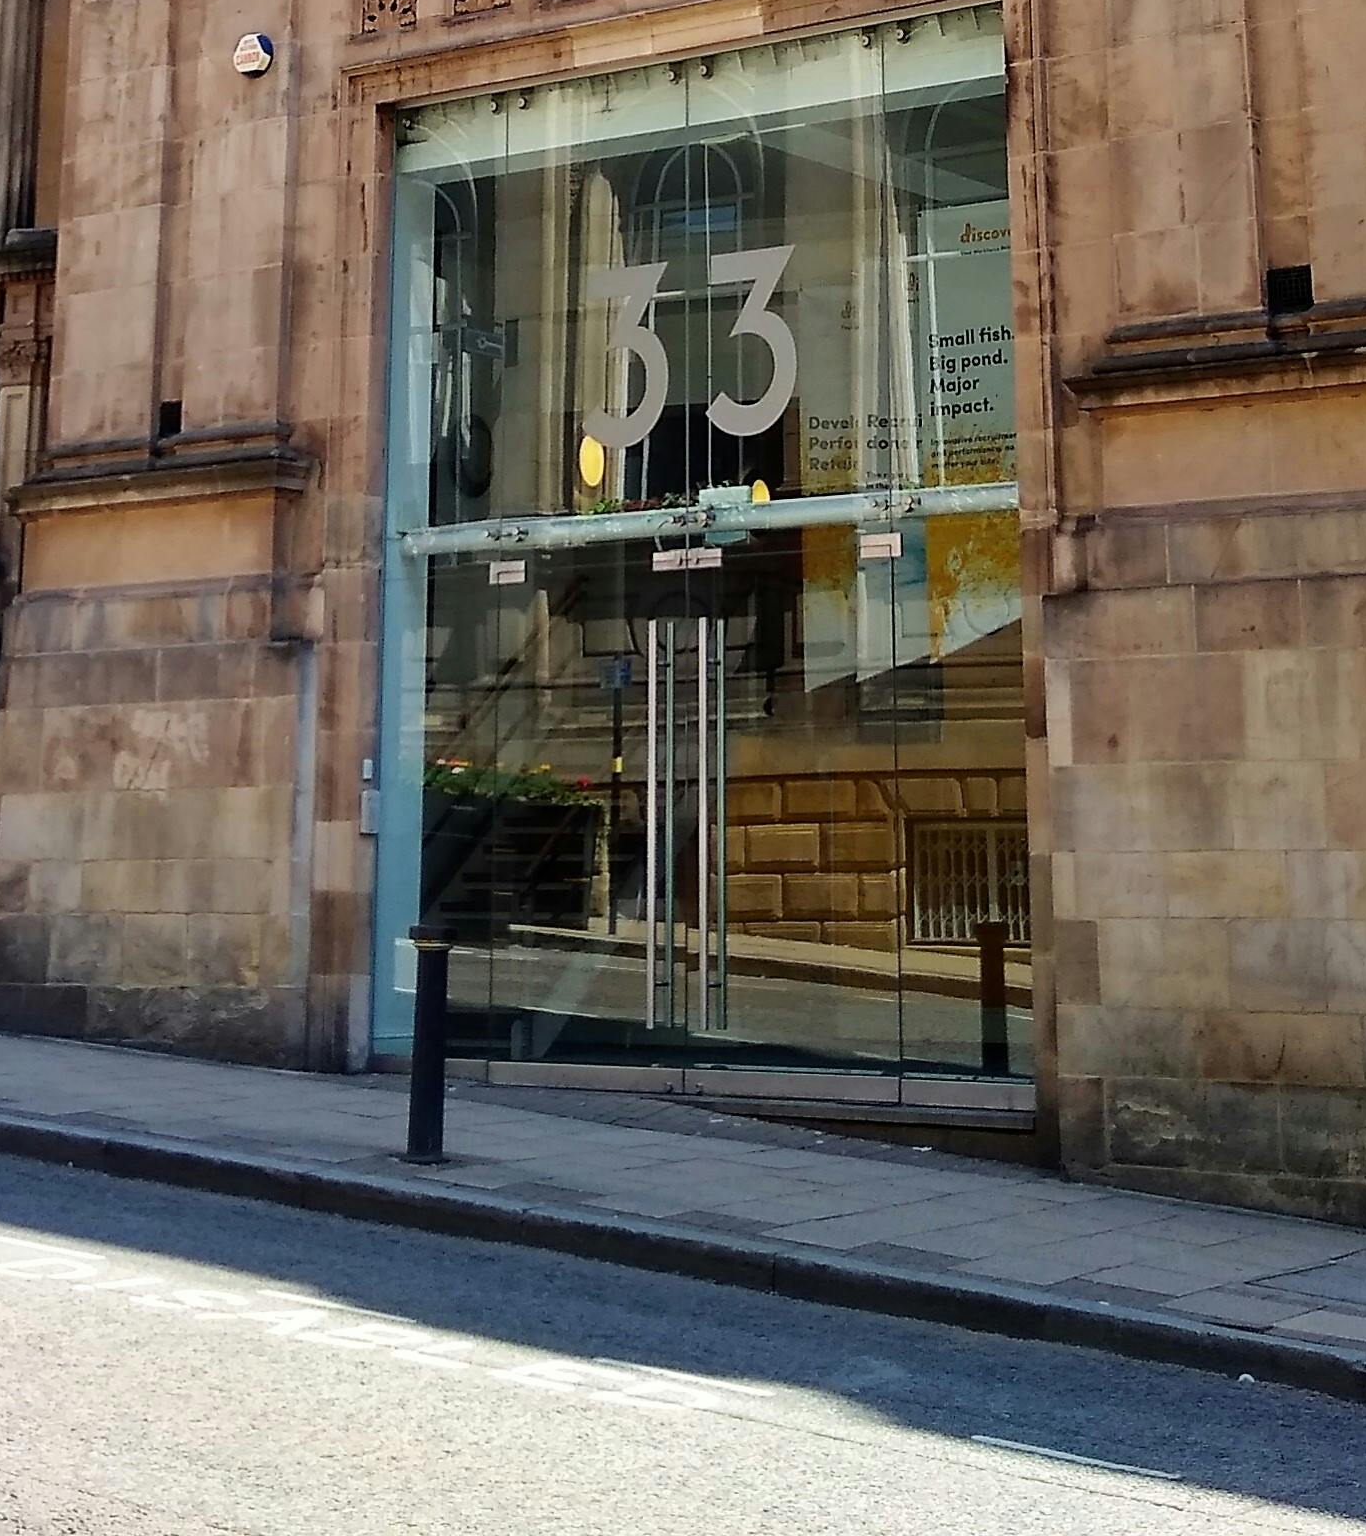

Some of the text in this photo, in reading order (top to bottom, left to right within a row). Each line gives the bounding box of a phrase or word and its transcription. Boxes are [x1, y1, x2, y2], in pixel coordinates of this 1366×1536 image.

[928, 325, 1015, 349] Small fish.
[961, 348, 1008, 373] pond.
[929, 376, 980, 396] Major
[930, 397, 994, 419] impact.
